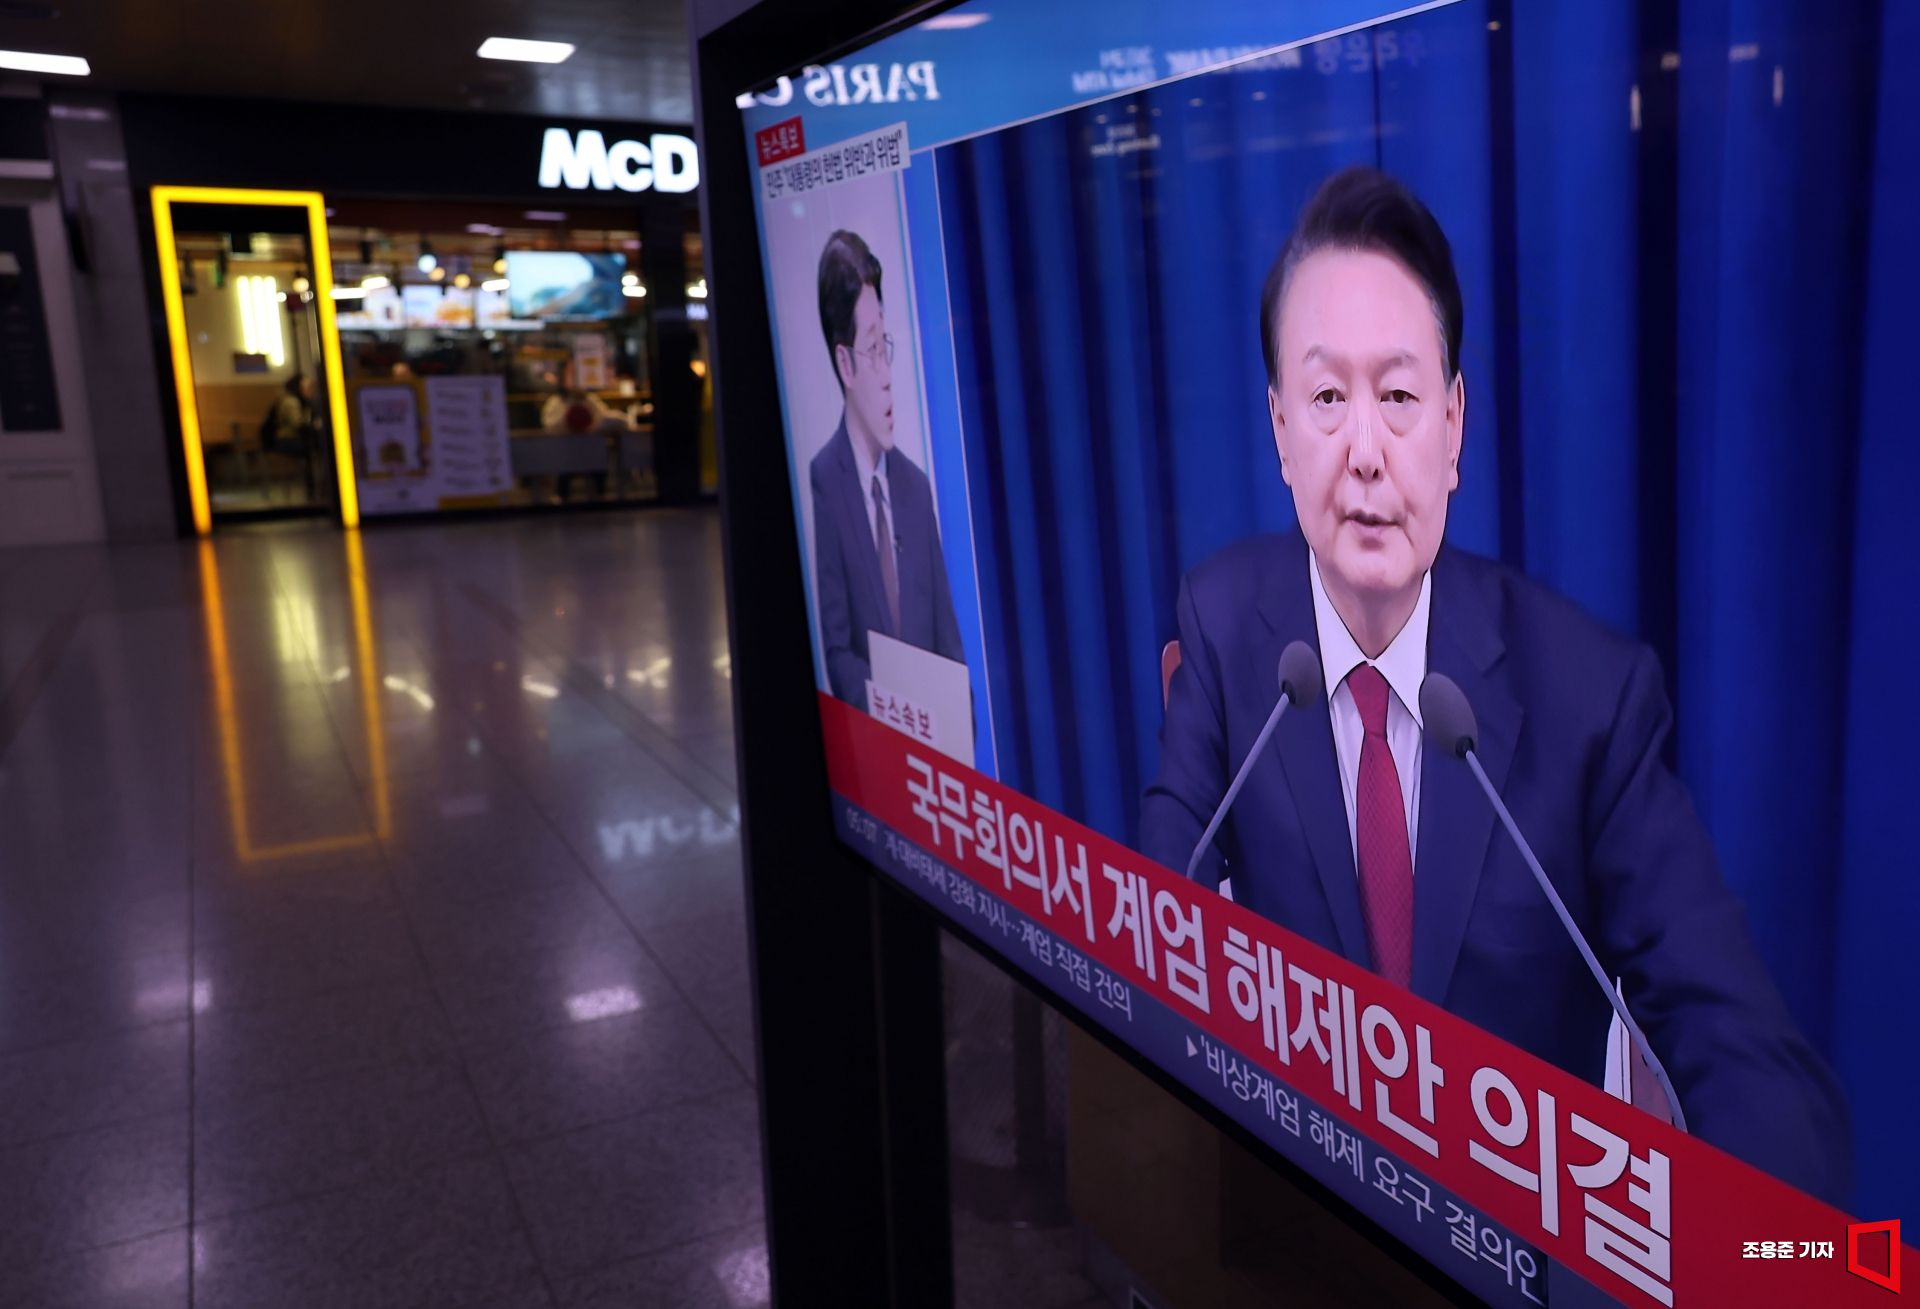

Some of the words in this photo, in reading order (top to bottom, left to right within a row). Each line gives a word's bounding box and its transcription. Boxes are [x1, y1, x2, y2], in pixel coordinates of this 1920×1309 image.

[538, 127, 699, 193] McD
[761, 124, 800, 160] 뉴스특보
[844, 140, 876, 174] 위반과
[872, 687, 933, 740] 뉴스속보
[1055, 942, 1091, 993] 직접
[1094, 967, 1133, 1022] 건의
[906, 753, 1096, 943] 국무회의서
[1102, 863, 1211, 1015] 계엄
[1222, 926, 1445, 1159] 해제안
[1469, 1066, 1674, 1307] 의결
[1308, 1110, 1364, 1182] 해제
[1373, 1156, 1436, 1222] 요구
